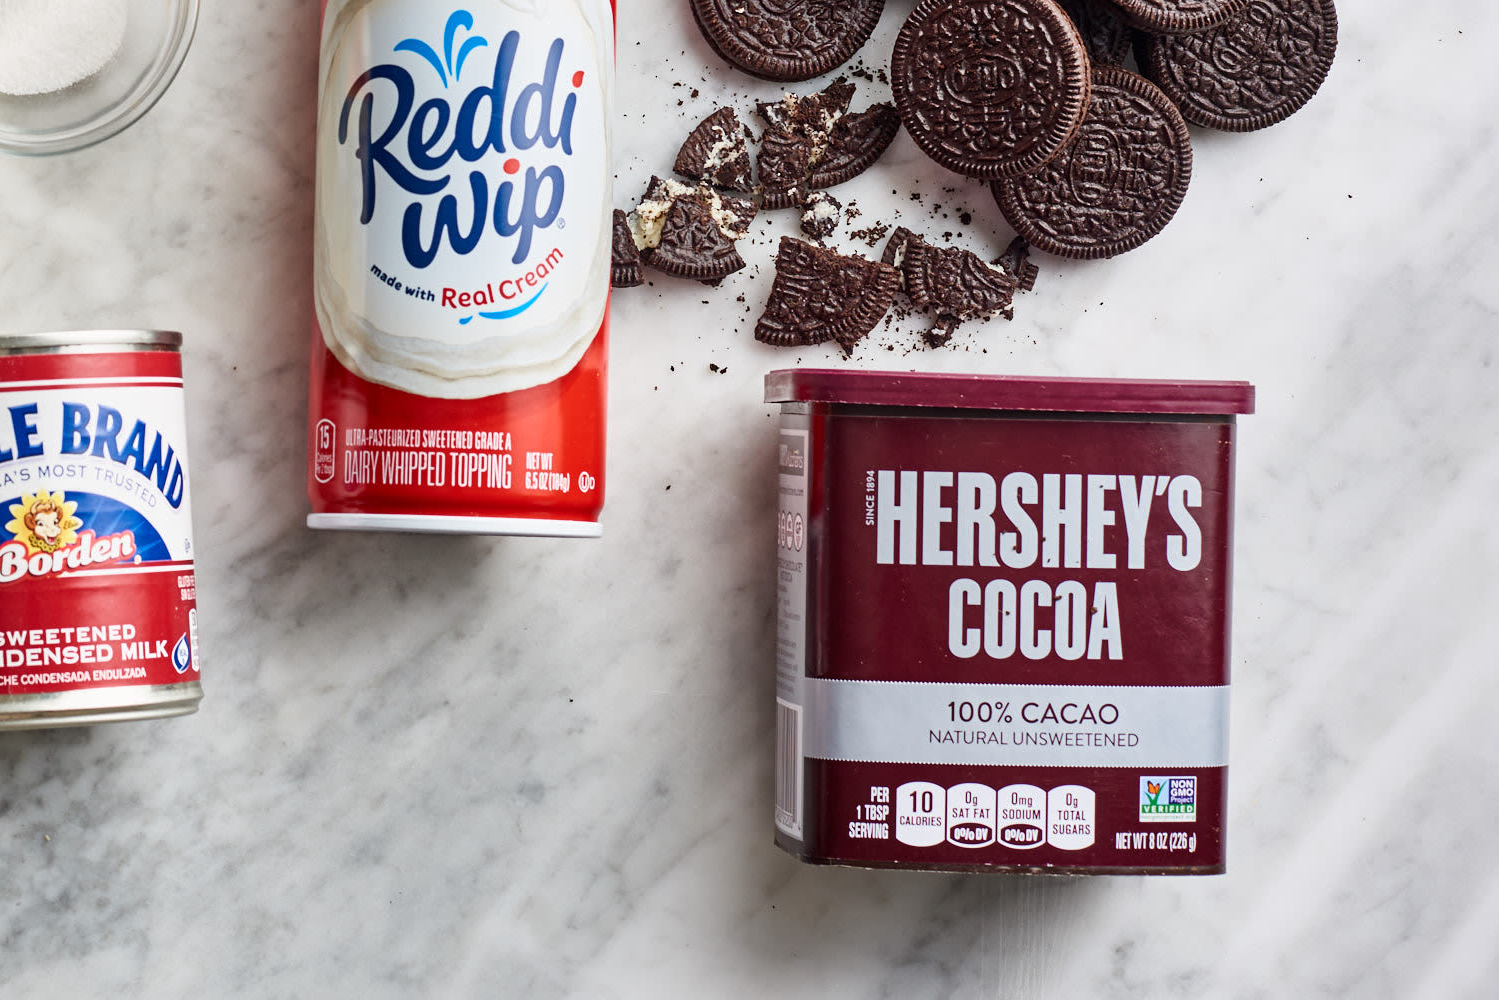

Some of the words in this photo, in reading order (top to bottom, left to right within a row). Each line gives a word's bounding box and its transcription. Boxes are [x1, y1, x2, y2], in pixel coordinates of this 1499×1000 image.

[339, 30, 584, 224] Reddi
[370, 264, 403, 291] made
[404, 285, 435, 302] with
[441, 283, 495, 309] Real
[498, 247, 564, 300] Cream
[320, 425, 330, 449] 15
[345, 428, 421, 448] ULTRA-PASTEURIZED
[422, 430, 473, 450] SWEETENED
[474, 431, 503, 450] GRADE
[503, 432, 512, 451] A
[61, 402, 184, 510] BRAND
[526, 452, 540, 470] NET
[540, 452, 553, 470] WT
[344, 450, 378, 484] DAIRY
[381, 451, 445, 487] WHIPPED
[449, 452, 512, 489] TOPPING
[38, 464, 87, 478] MOST
[94, 467, 157, 508] TRUSTED
[866, 470, 875, 492] 1894
[865, 494, 875, 526] SINCE
[876, 469, 1202, 571] HERSHEY'S
[948, 577, 1123, 661] COCOA
[121, 640, 169, 661] MILK
[21, 670, 91, 685] CONDENSADA
[93, 667, 147, 681] ENDULZADA
[948, 700, 1012, 724] 100%
[1021, 701, 1119, 725] CACAO
[928, 728, 1007, 746] NATURAL
[1012, 729, 1139, 748] UNSWEETENED
[1170, 788, 1194, 797] GMO
[1171, 779, 1194, 788] NON
[870, 786, 889, 803] PER
[909, 790, 933, 813] 10
[965, 790, 978, 806] 0g
[1011, 791, 1033, 807] 0mg
[1065, 792, 1079, 808] 0g
[856, 805, 862, 819] 1
[865, 805, 889, 822] TBSP
[952, 807, 970, 819] SAT
[973, 808, 990, 819] FAT
[1002, 808, 1041, 820] SODIUM
[1058, 810, 1086, 821] TOTAL
[1143, 805, 1193, 813] VERIFIED
[849, 821, 889, 839] SERVING
[899, 815, 942, 826] CALORIES
[1052, 823, 1091, 835] SUGARS
[1115, 832, 1131, 849] NET
[1132, 832, 1148, 849] WT
[1149, 832, 1155, 849] 8
[1156, 832, 1168, 849] OZ
[1169, 832, 1187, 852] (226
[1188, 832, 1197, 852] g)
